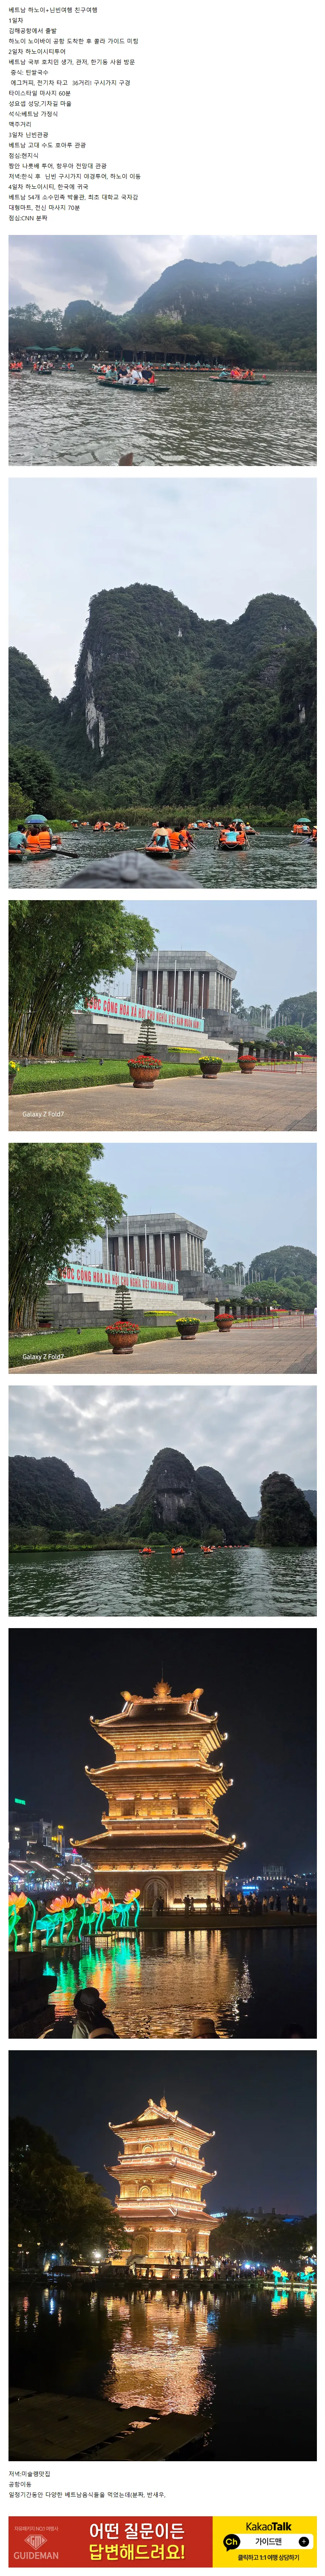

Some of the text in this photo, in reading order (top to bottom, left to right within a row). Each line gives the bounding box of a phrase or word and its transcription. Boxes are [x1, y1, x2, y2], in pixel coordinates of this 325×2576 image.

[103, 999, 118, 1014] CỘNG
[120, 1003, 129, 1016] HÒA
[131, 1005, 137, 1017] XÃ
[147, 1008, 155, 1021] CHỦ
[156, 1012, 167, 1023] NGHĨA
[77, 1267, 91, 1283] CỘNG
[93, 1270, 103, 1283] HÒA
[104, 1272, 111, 1284] XÃ
[121, 1274, 129, 1286] CHỦ
[130, 1277, 141, 1288] NGHĨA
